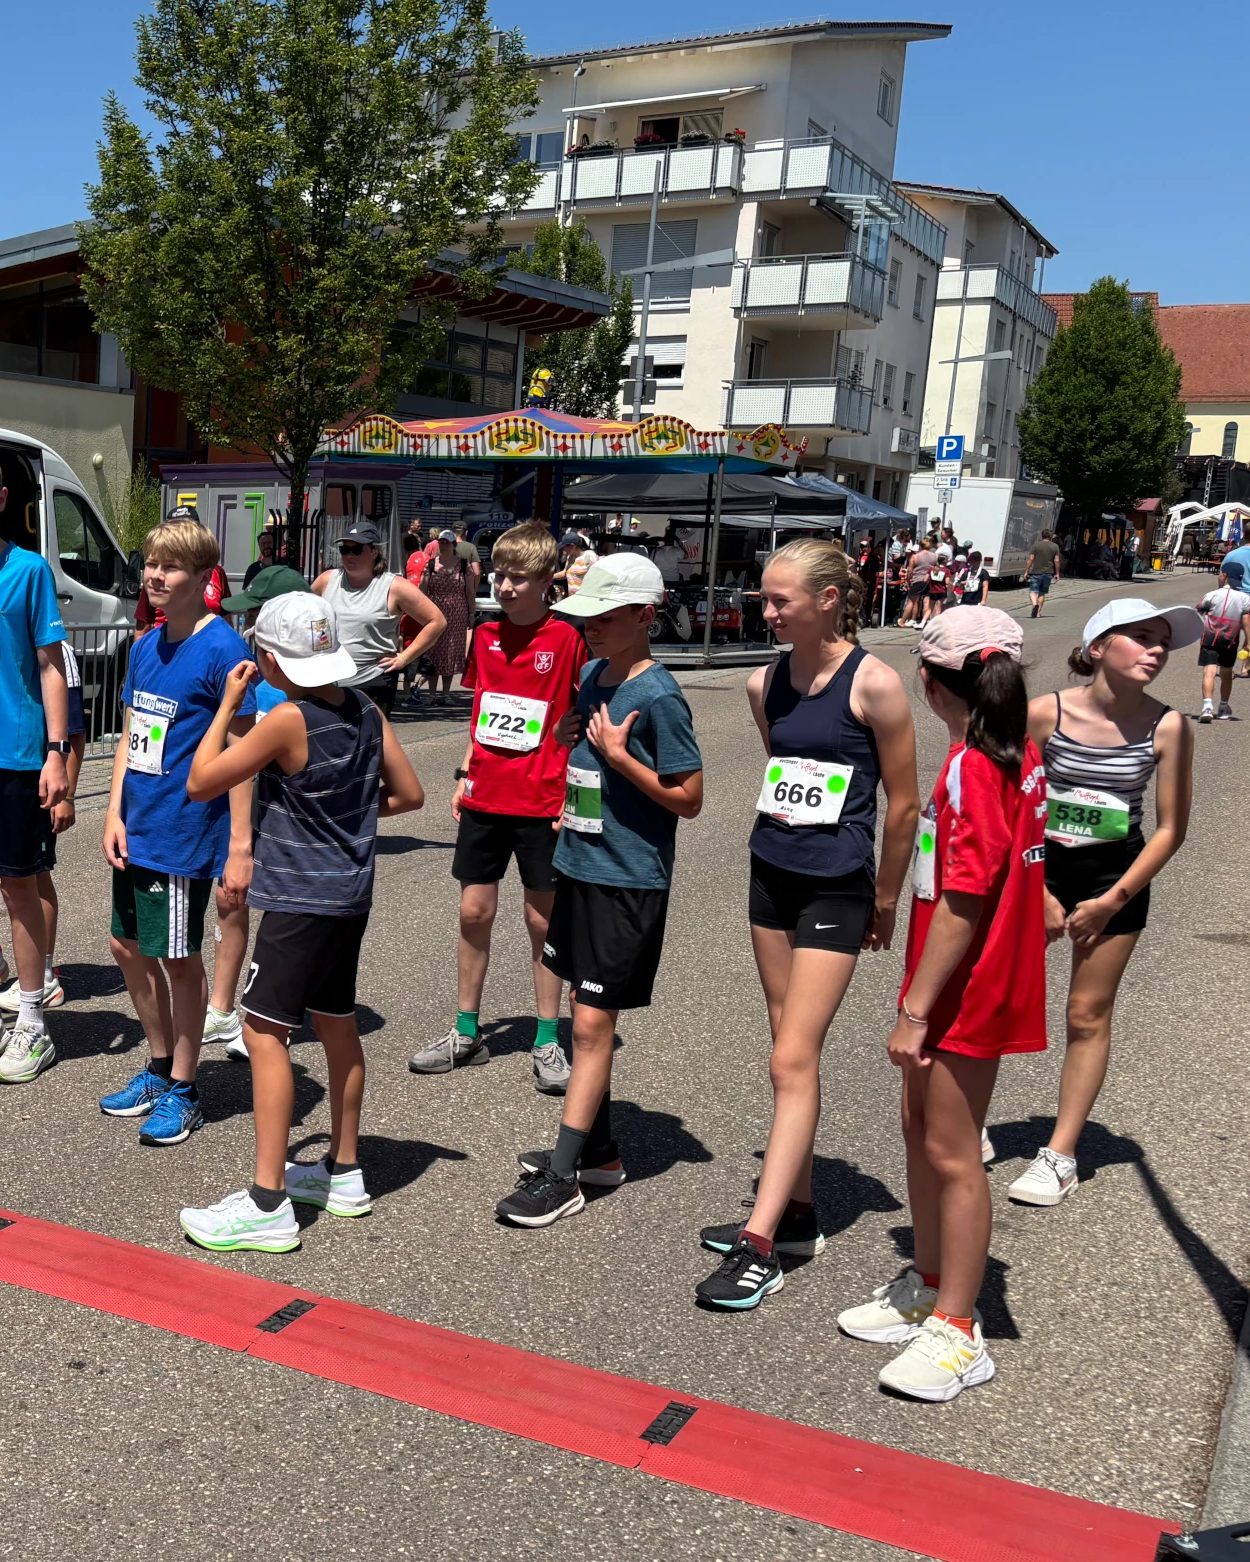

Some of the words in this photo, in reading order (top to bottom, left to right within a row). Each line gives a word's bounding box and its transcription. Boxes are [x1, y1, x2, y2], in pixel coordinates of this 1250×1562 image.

[942, 438, 958, 458] P
[155, 699, 175, 714] werk
[488, 712, 526, 734] 722
[568, 786, 579, 804] 01
[774, 781, 823, 807] 666
[1055, 804, 1102, 825] 538
[1059, 823, 1092, 836] LENA
[580, 980, 604, 994] JAKO
